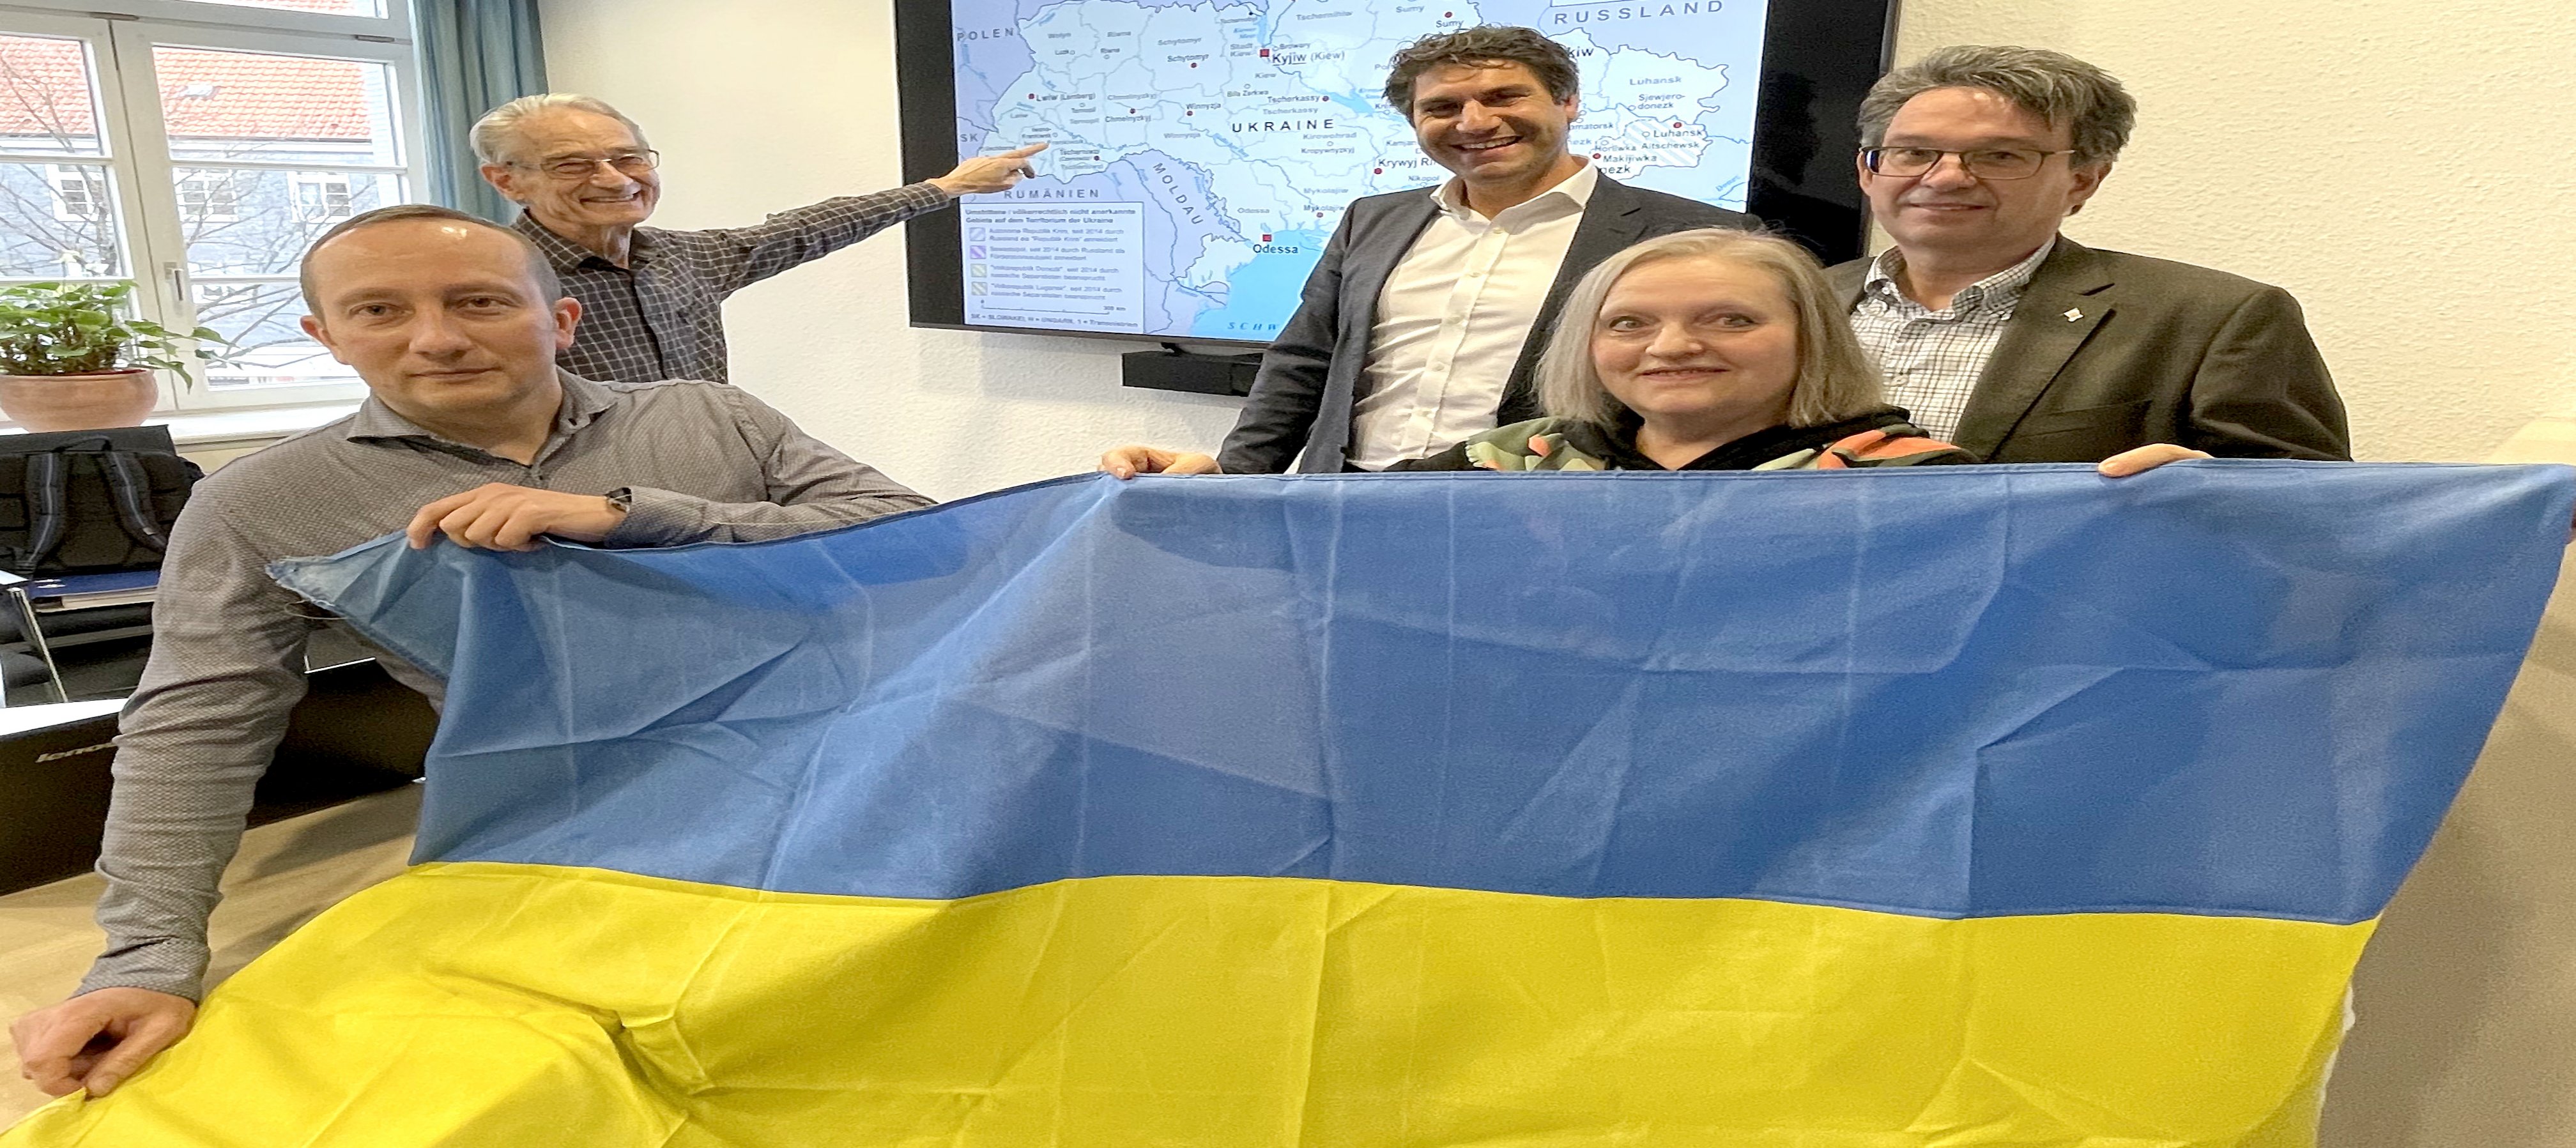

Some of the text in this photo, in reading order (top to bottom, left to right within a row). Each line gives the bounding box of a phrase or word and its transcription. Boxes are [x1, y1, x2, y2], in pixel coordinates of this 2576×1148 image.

[1554, 1, 1723, 24] RUSSLAND
[1436, 20, 1464, 29] Sumy
[957, 27, 1014, 41] POLEN
[1273, 50, 1345, 65] Kyjiw (Kiew)
[1630, 76, 1682, 86] Luhansk
[1268, 95, 1321, 103] Tscherkassy
[1232, 119, 1334, 133] UKRAINE
[960, 134, 978, 142] SK
[1653, 129, 1703, 138] Luhansk
[1378, 158, 1417, 169] Krywyj
[1603, 155, 1657, 164] Makijiwka
[1600, 165, 1630, 174] nezk
[1004, 188, 1099, 199] RUMÄNIEN
[1153, 162, 1204, 225] MOLDAU
[1252, 244, 1298, 254] Odessa
